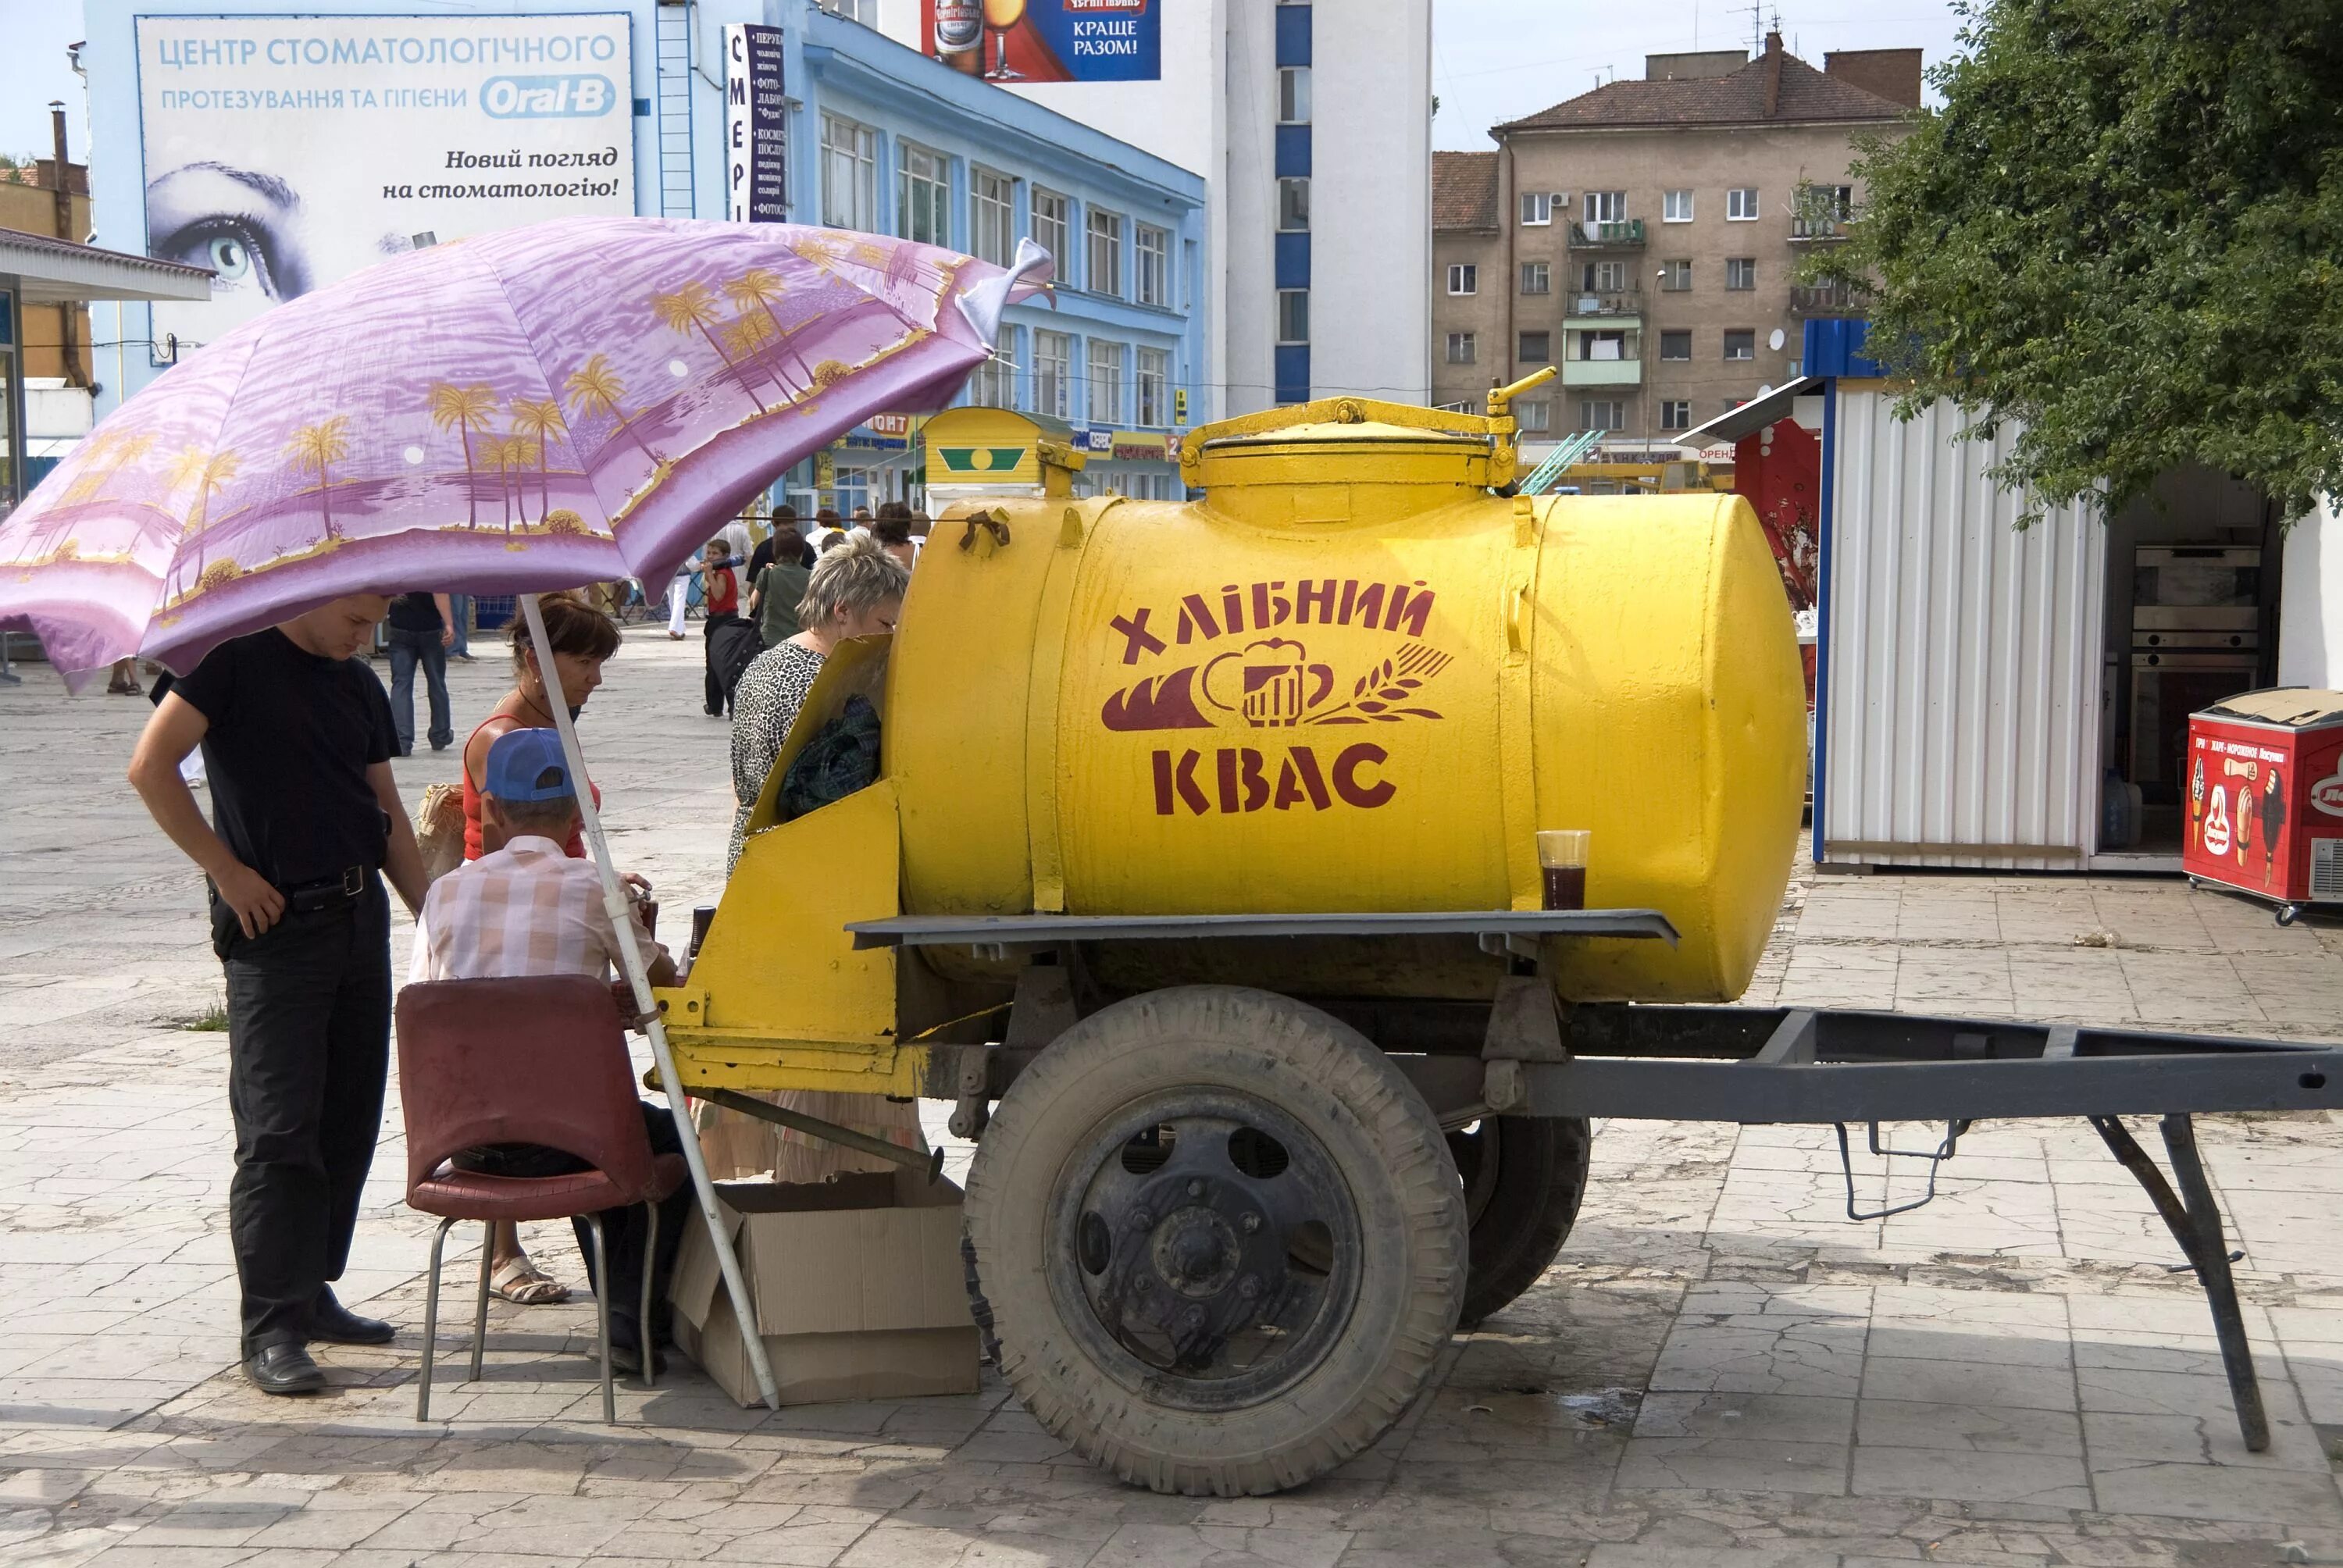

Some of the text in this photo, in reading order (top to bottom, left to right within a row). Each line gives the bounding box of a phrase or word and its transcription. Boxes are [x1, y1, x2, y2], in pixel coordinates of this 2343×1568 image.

[1073, 20, 1137, 36] КРАЩЕ
[159, 34, 615, 70] ЦЕНТР СТОМАТОЛОГІЧНОГО
[1073, 40, 1137, 55] РАЗОМ!
[162, 87, 467, 109] ПРОТЕЗУВАННЯ ТА ГІГІЄНИ
[487, 79, 605, 115] Oral-B
[445, 147, 618, 169] Новий погляд
[383, 177, 619, 199] на стоматологію!
[1109, 579, 1435, 665] ХЛІБНИЙ
[1151, 742, 1397, 816] КВАС
